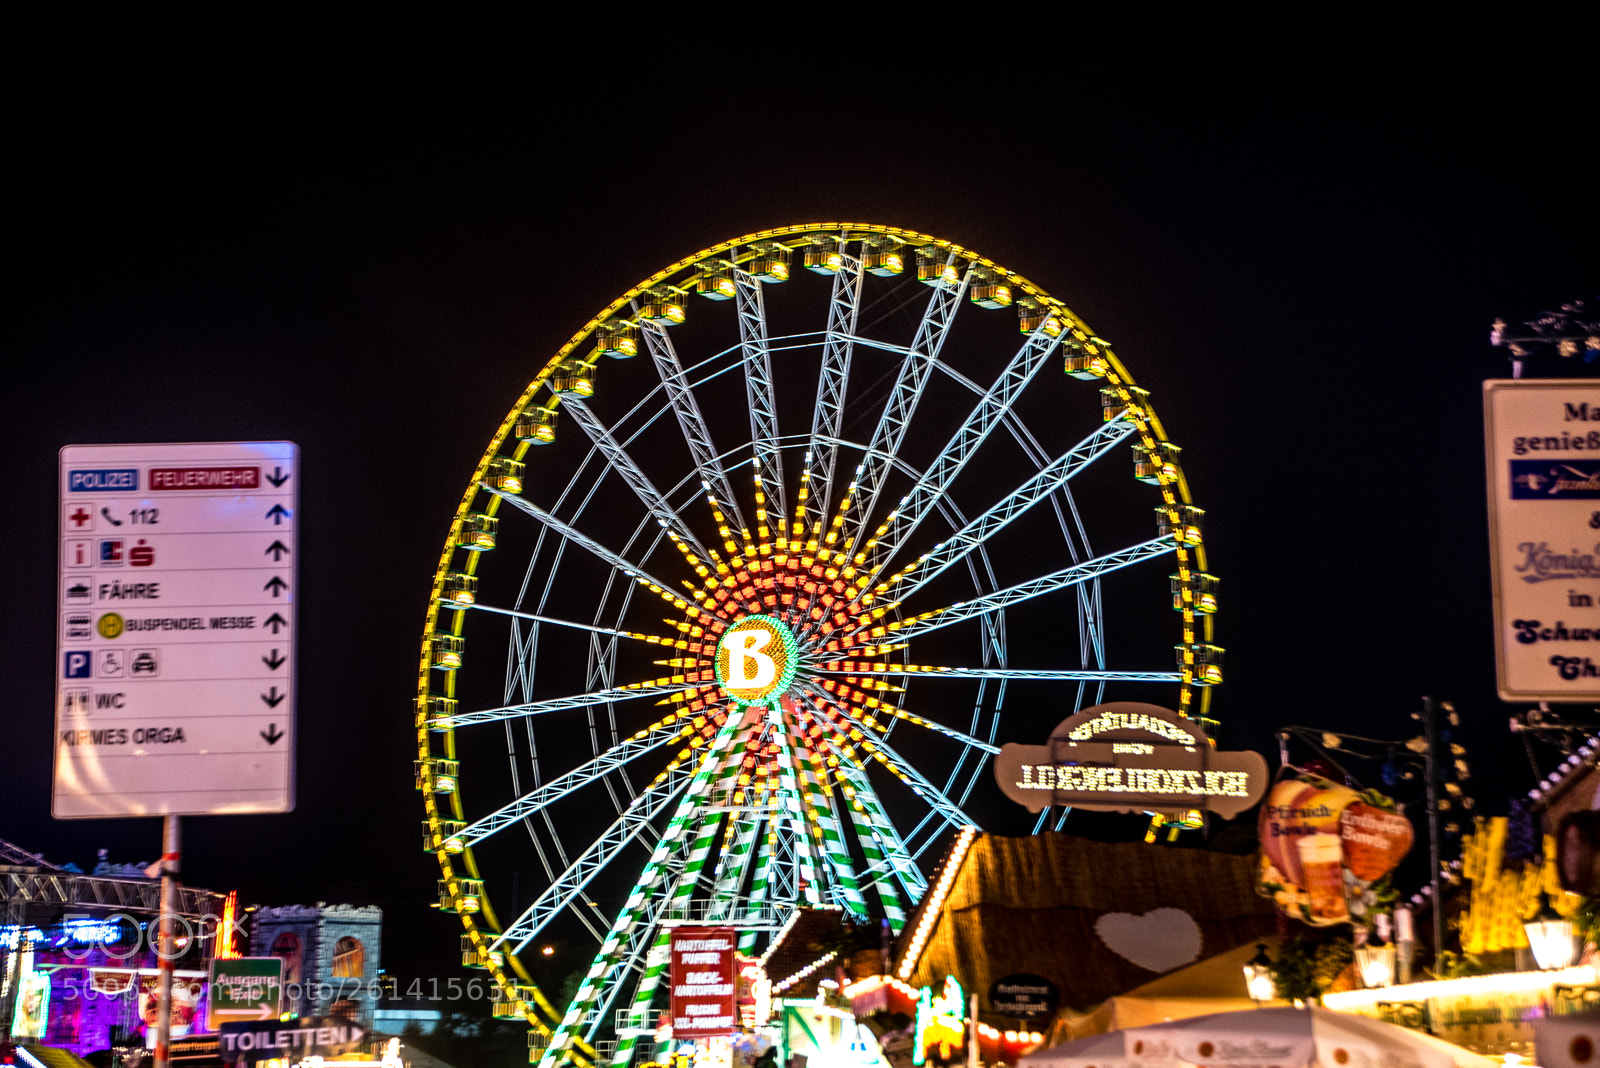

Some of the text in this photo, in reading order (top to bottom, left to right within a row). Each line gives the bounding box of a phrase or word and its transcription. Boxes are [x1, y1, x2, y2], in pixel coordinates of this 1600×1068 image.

[71, 470, 256, 488] POLIZEI FEUERWEHR
[129, 508, 160, 525] 112
[99, 579, 161, 600] FÄHRE
[1568, 590, 1593, 607] in
[125, 617, 207, 632] BUSPENDEL
[209, 616, 256, 630] MESSE
[68, 654, 87, 676] P
[723, 630, 776, 689] B
[1549, 655, 1600, 680] Th
[95, 692, 126, 709] WC
[60, 727, 186, 746] KIRMES ORGA
[216, 973, 279, 988] Ausgang
[222, 1027, 348, 1051] TOILETTEN
